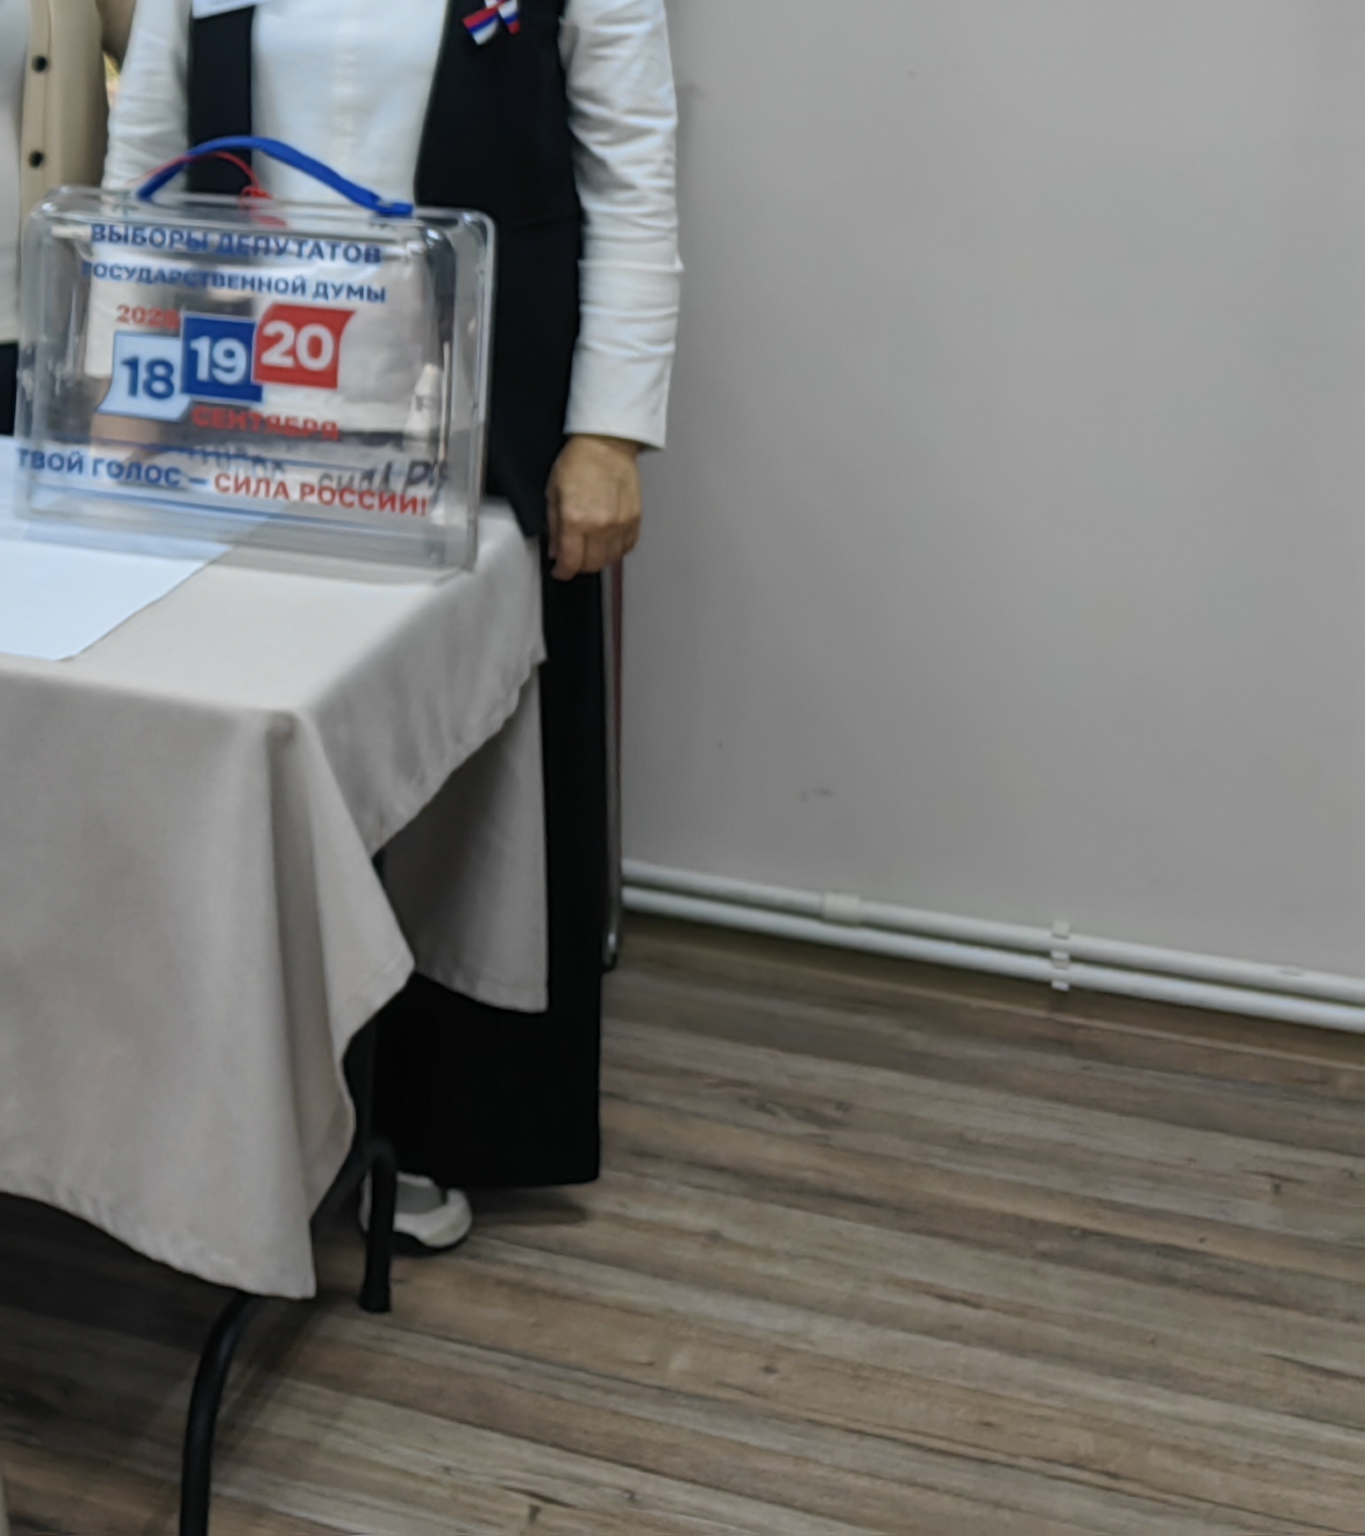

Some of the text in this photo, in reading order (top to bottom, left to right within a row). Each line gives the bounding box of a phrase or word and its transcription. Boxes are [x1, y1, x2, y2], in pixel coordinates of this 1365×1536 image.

[90, 222, 382, 265] ВЫБОРЫ ДЕПУТАТОВ
[82, 260, 387, 304] ГОСУДАРСТВЕННОЙ ДУМЫ
[189, 335, 248, 386] 19
[260, 319, 335, 372] 20
[121, 354, 175, 400] 18
[190, 404, 341, 442] СЕНТЯБРЯ
[16, 446, 86, 476] ТВОЙ
[91, 456, 183, 488] ГОЛОС
[213, 471, 290, 502] СИЛА
[298, 483, 429, 517] РОССИИ!
